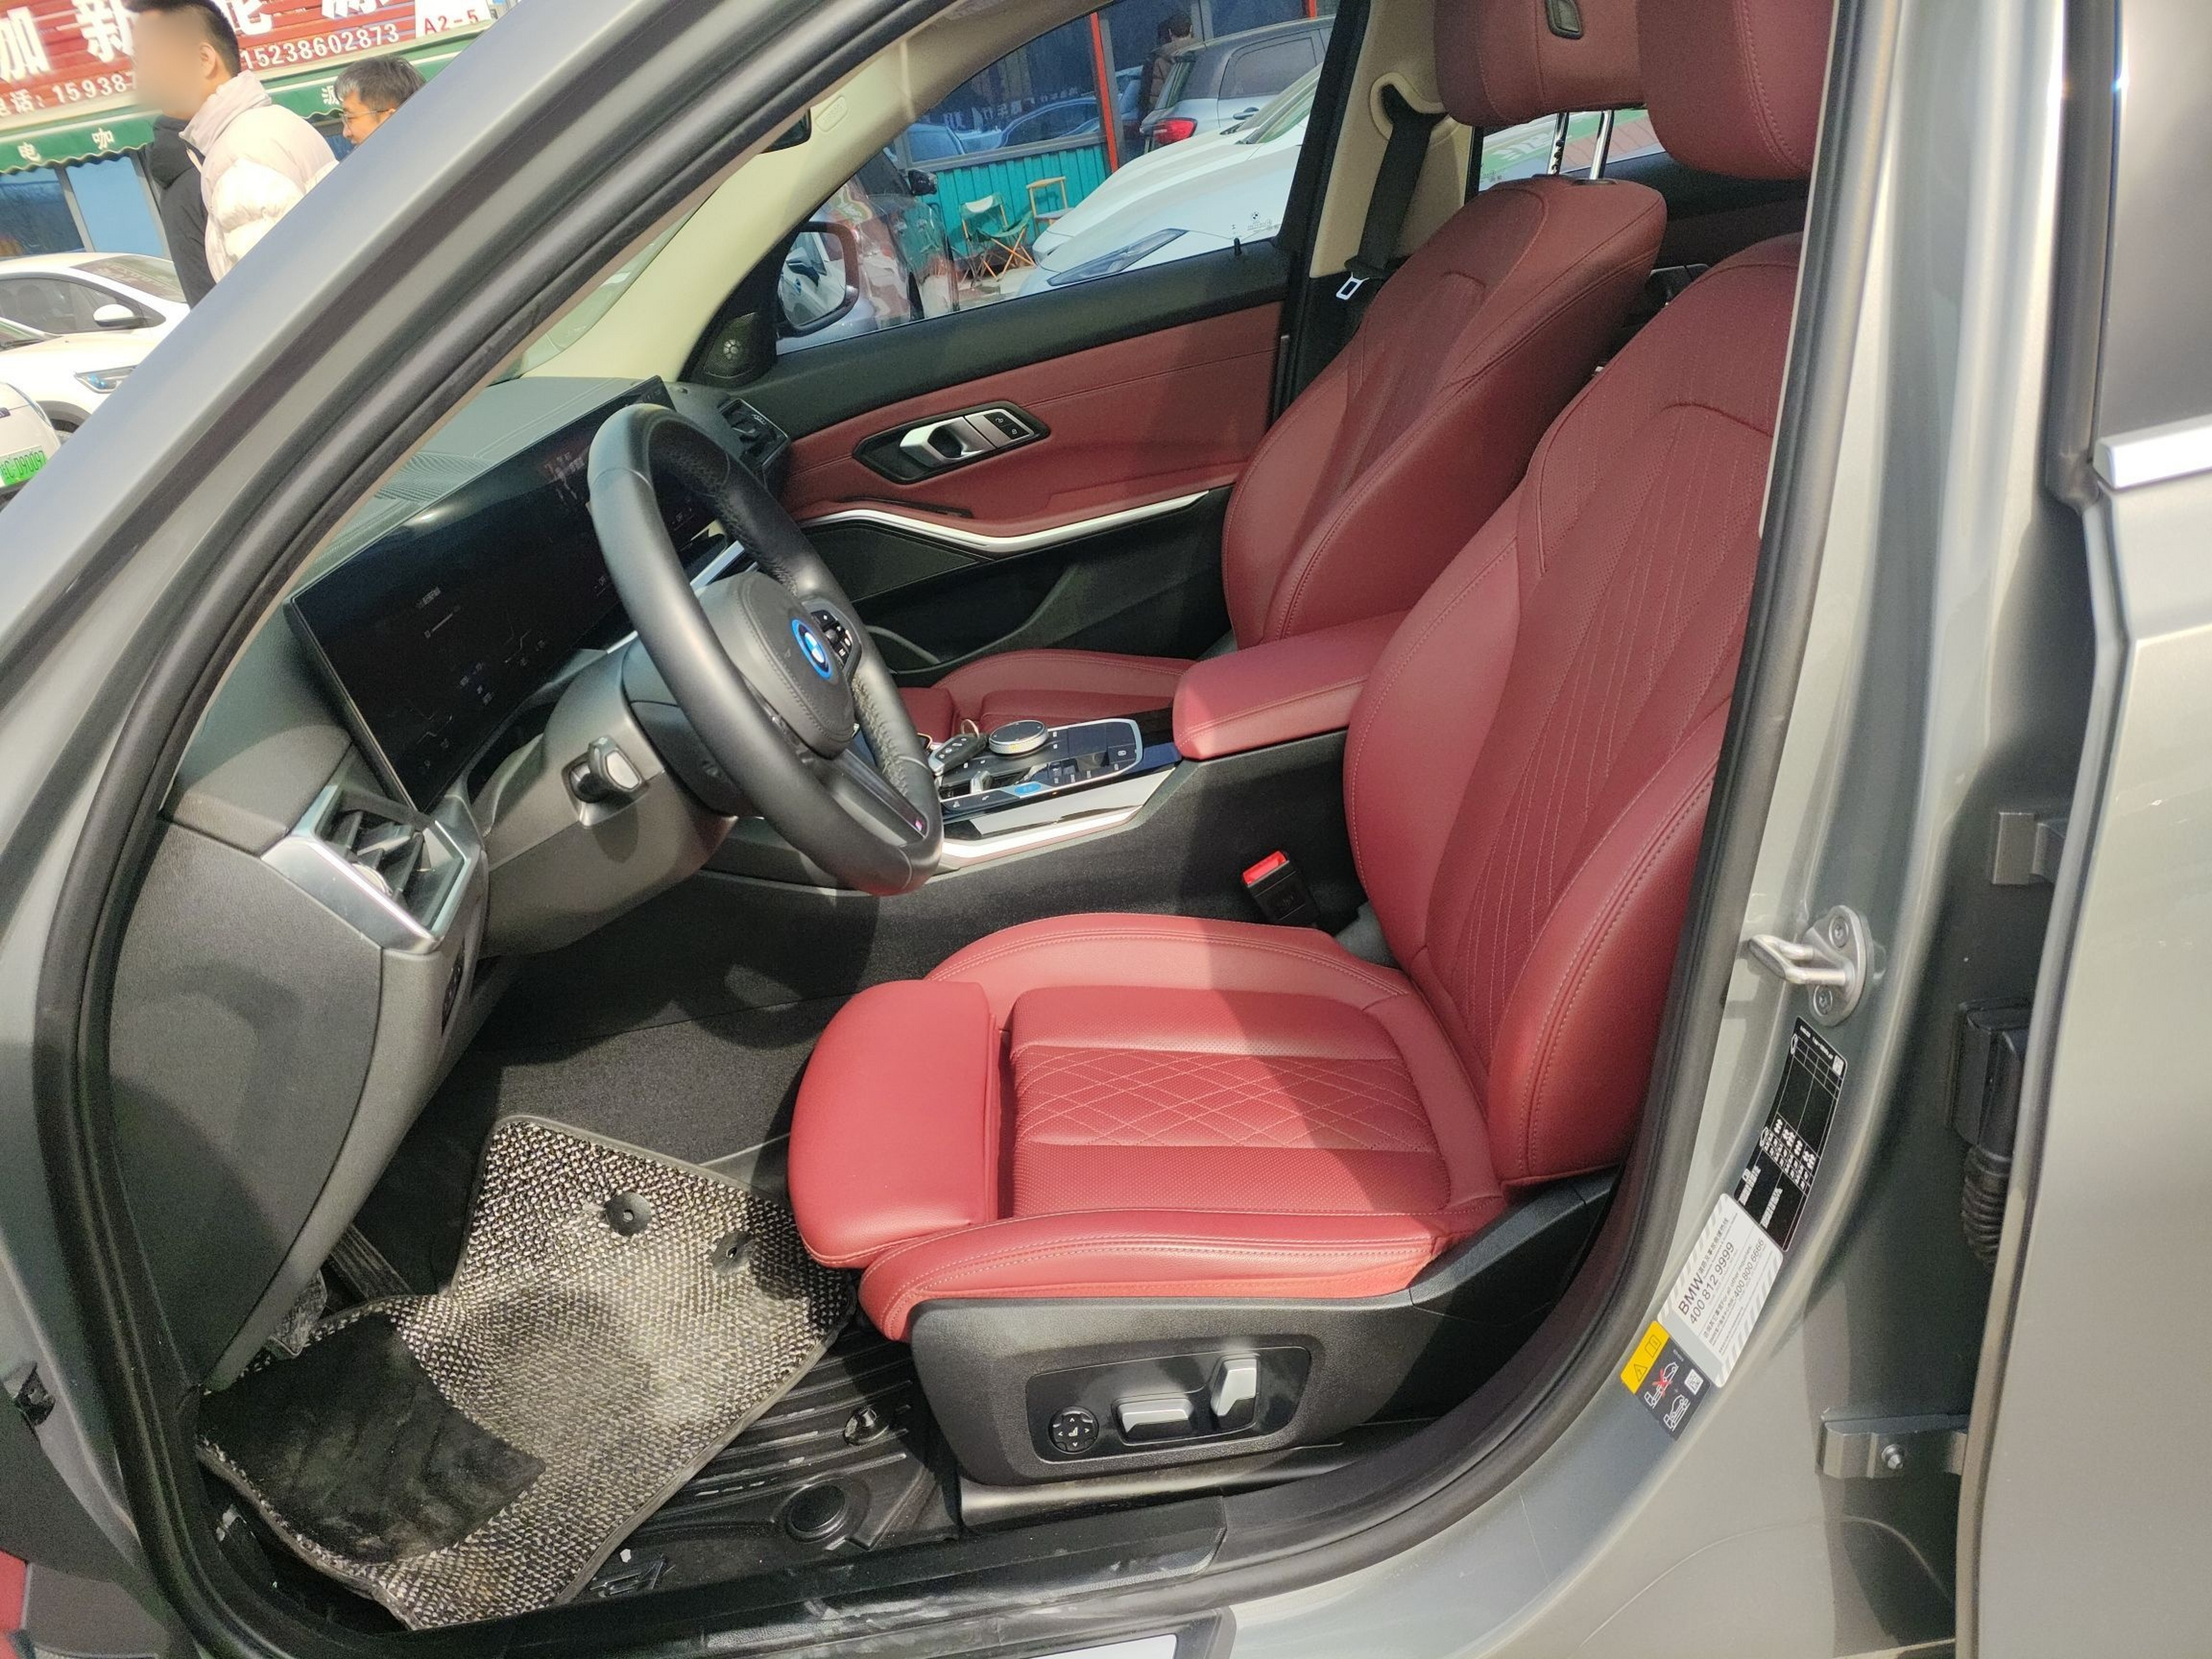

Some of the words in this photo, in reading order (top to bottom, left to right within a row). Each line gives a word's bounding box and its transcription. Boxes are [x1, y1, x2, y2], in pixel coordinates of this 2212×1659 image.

[425, 9, 479, 35] A2-5
[241, 24, 399, 70] 15238602873
[1688, 1297, 1705, 1325] 400
[1701, 1272, 1718, 1301] 812
[1713, 1240, 1734, 1276] 9999
[1732, 1279, 1745, 1298] 400
[1741, 1261, 1753, 1281] 800
[1749, 1238, 1764, 1262] 6666
[1678, 1272, 1703, 1315] BMW
